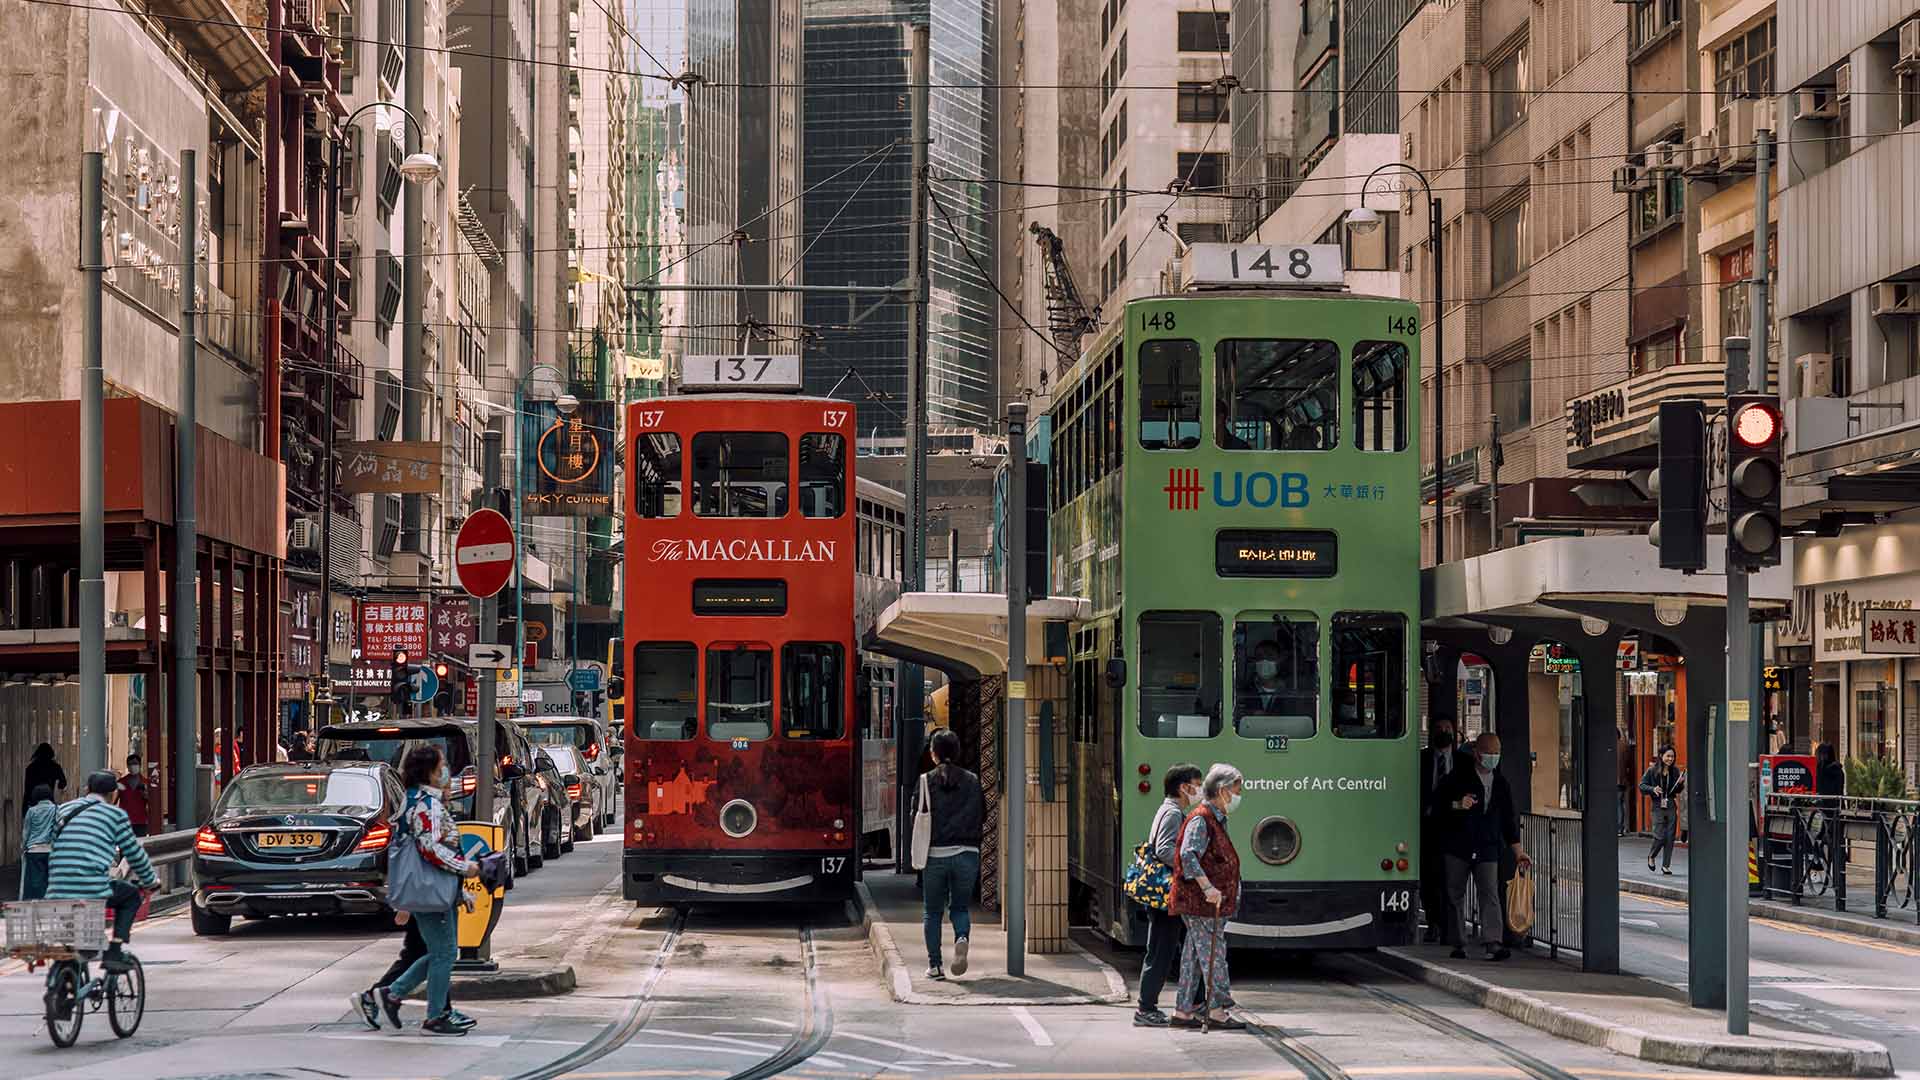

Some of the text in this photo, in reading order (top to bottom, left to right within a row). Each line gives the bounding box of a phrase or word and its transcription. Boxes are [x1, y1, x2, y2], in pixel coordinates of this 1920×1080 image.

[1230, 248, 1312, 279] 148
[1141, 311, 1176, 331] 148
[1388, 315, 1417, 336] 148
[714, 357, 772, 382] 137
[639, 410, 664, 428] 137
[823, 410, 848, 428] 137
[1213, 471, 1310, 508] UOB
[1323, 484, 1385, 500] 大華銀行
[527, 494, 563, 504] SKY
[648, 539, 836, 562] The MACALLAN
[732, 741, 748, 749] 004
[1267, 739, 1287, 749] 032
[1241, 776, 1387, 790] artner of Art Central
[266, 834, 314, 845] DV 339
[821, 857, 846, 874] 137
[1381, 891, 1409, 911] 148
